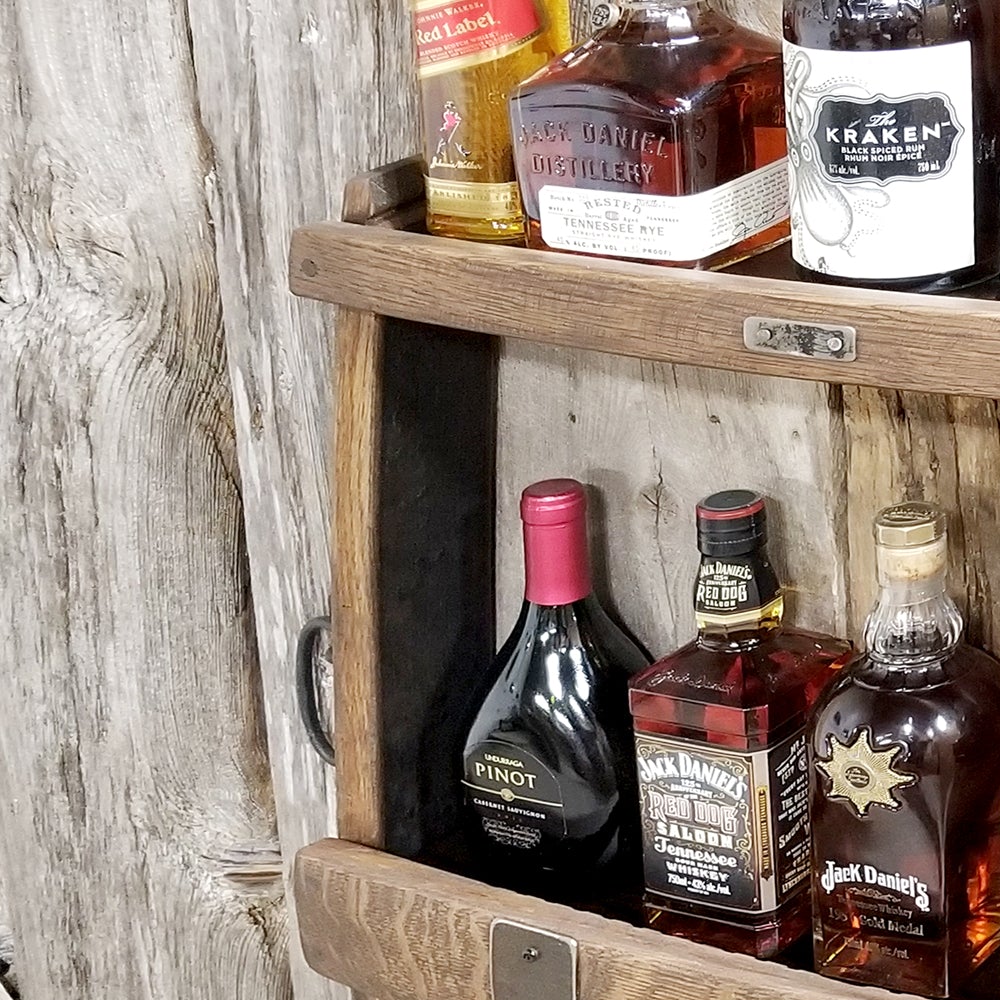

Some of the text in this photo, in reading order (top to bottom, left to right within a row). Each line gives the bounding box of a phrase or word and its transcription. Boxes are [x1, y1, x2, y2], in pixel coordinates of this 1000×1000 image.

[415, 26, 443, 46] Red
[865, 110, 897, 128] The
[518, 120, 572, 147] JACK
[826, 121, 941, 144] KRAKEN
[841, 144, 925, 154] BLACK SPICED RUM
[844, 154, 869, 162] RHUM
[871, 154, 894, 162] NOIR
[531, 152, 654, 185] DISTILLERY
[562, 217, 665, 236] TENNESSEE RYE
[696, 584, 748, 602] RED DOG
[475, 762, 537, 789] PINOT
[637, 752, 748, 802] JACK DANIEL'S
[656, 821, 734, 849] SALOON
[653, 835, 738, 868] Tennessee
[665, 861, 730, 882] WHISKEY
[821, 860, 930, 912] Jack Daniel's
